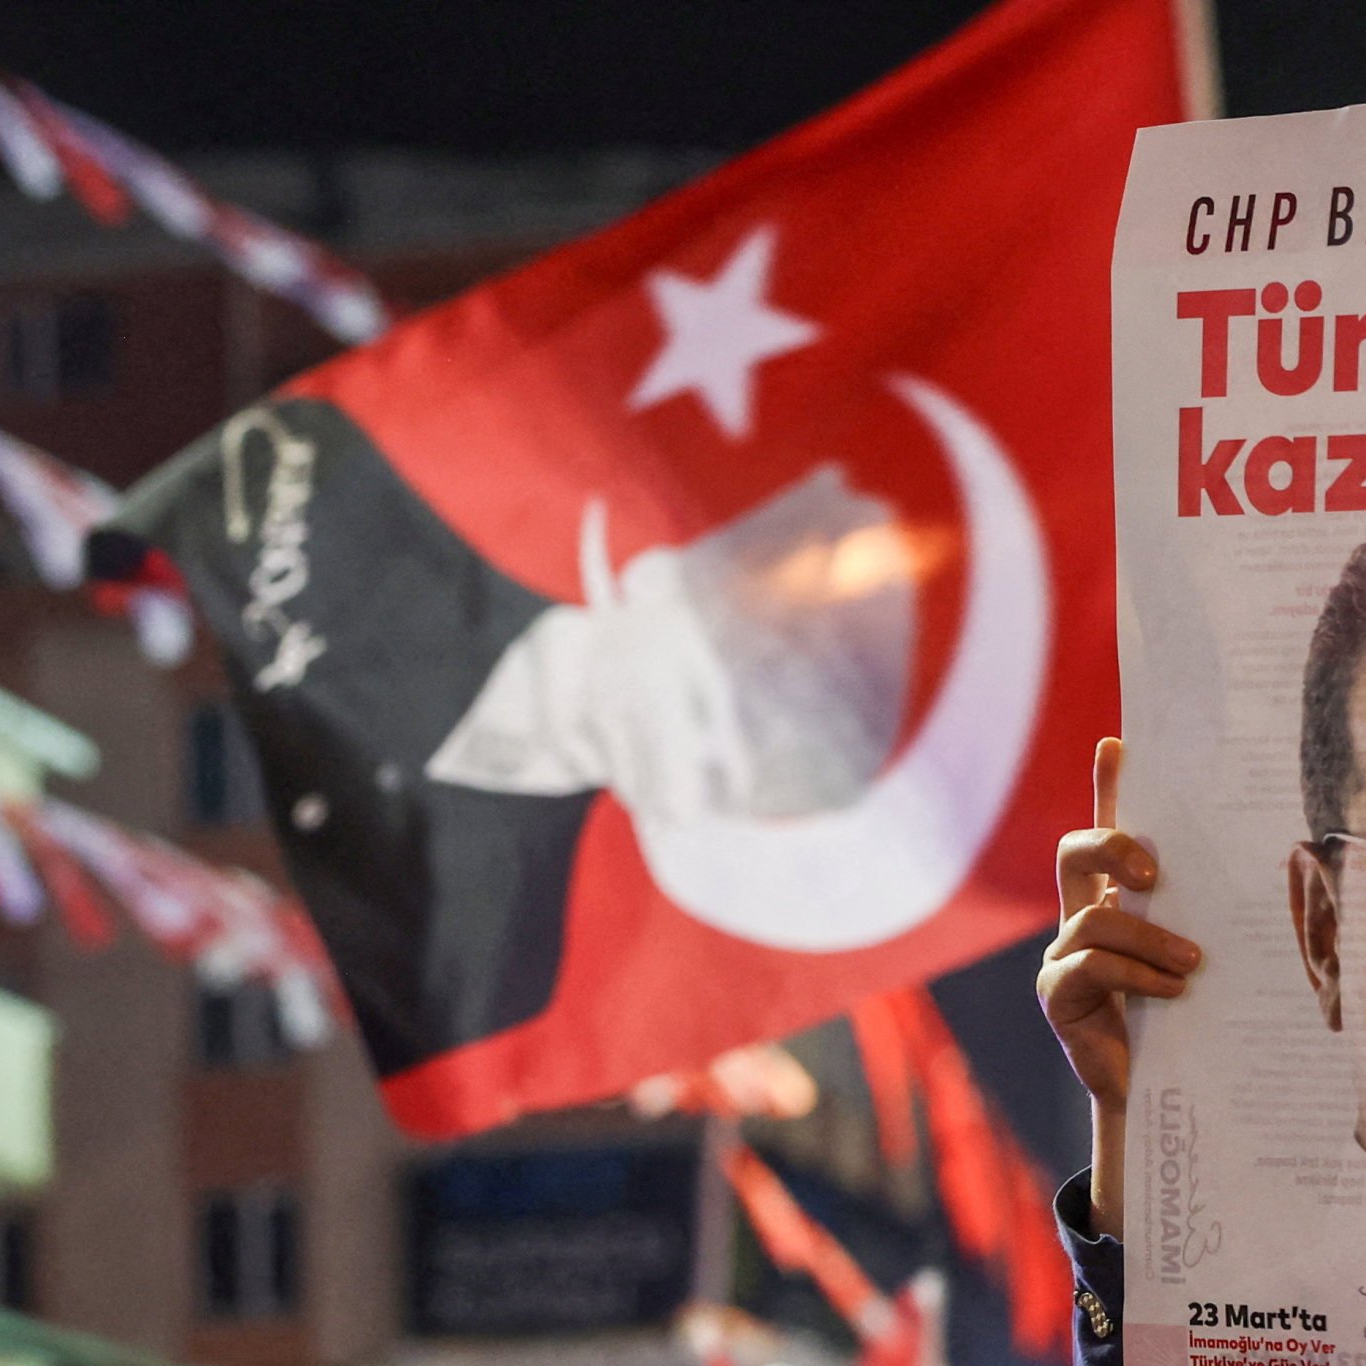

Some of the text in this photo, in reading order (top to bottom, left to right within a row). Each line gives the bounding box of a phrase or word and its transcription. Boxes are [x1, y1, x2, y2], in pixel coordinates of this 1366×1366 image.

[1186, 196, 1298, 256] CHP
[1188, 1301, 1328, 1333] 23 Mart'ta
[1188, 1329, 1337, 1356] İmamoğlu'na Oy Ver
